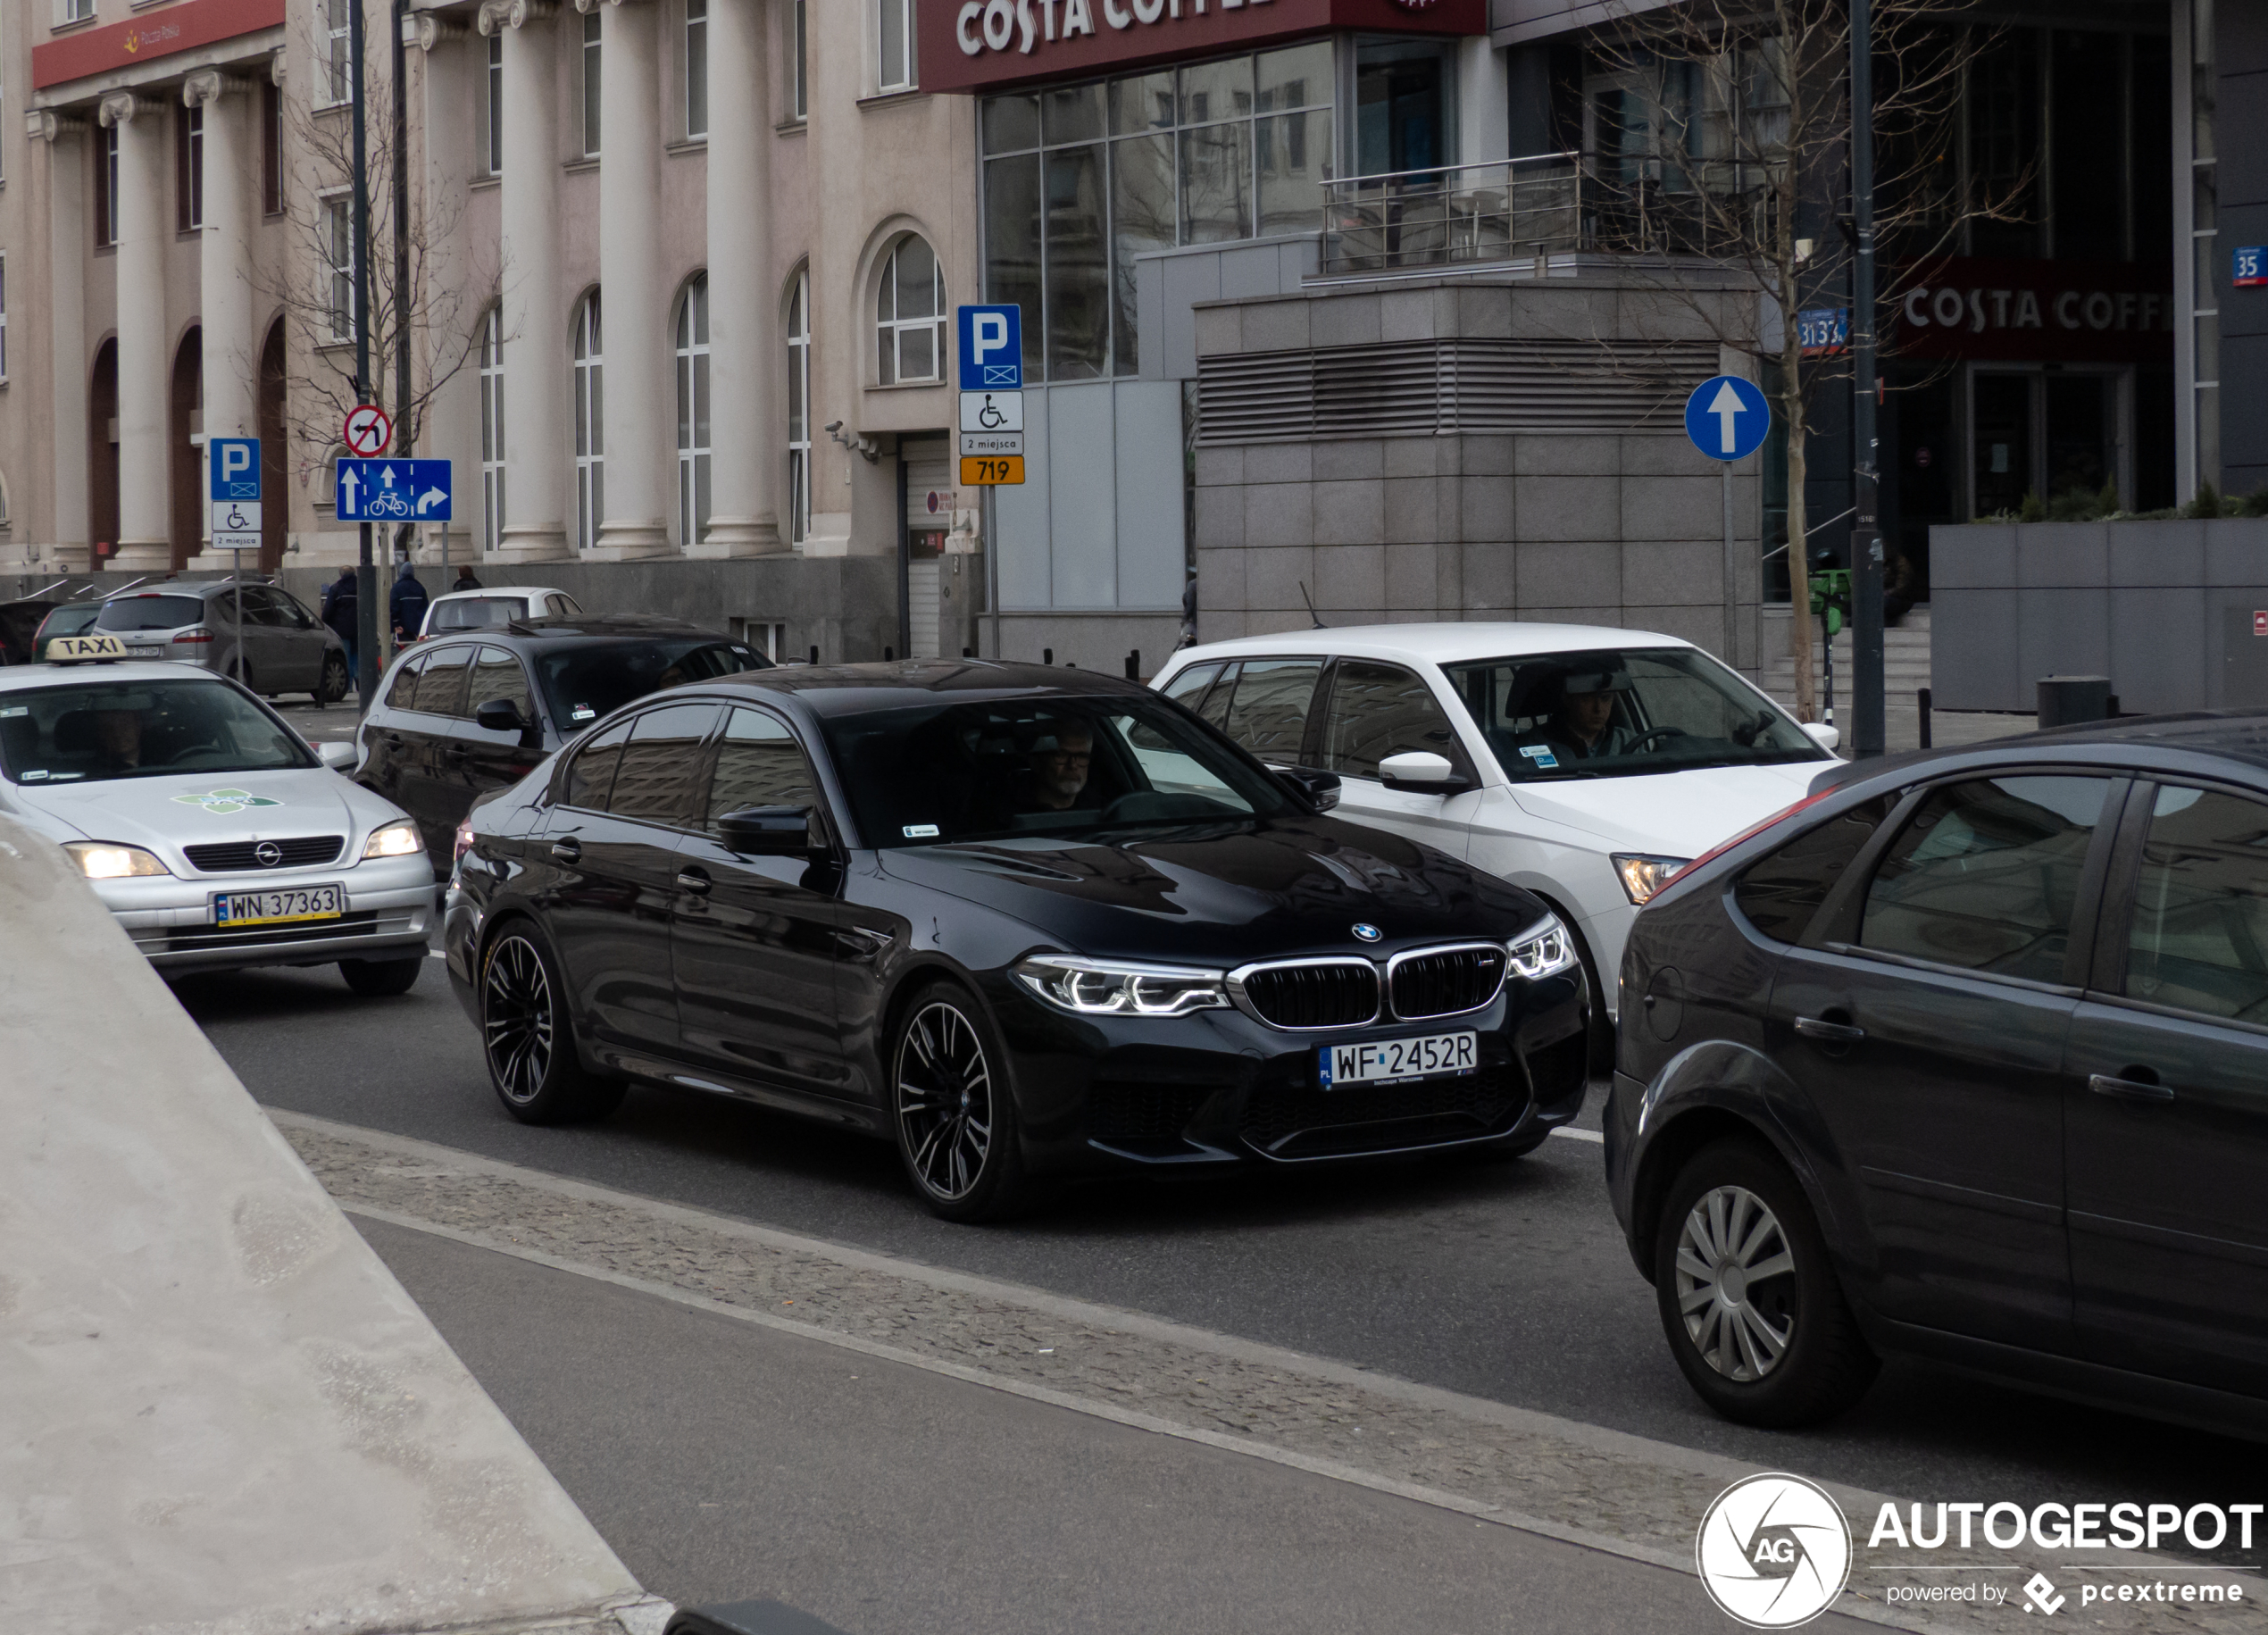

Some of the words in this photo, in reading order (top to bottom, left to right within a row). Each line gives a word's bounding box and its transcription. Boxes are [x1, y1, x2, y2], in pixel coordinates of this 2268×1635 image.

[956, 0, 1096, 55] COSTA
[2238, 255, 2258, 277] 35
[1905, 288, 2043, 333] COSTA
[973, 313, 1008, 365] P
[968, 439, 974, 449] 2
[978, 438, 1017, 454] miejsca
[221, 443, 250, 482] P
[977, 461, 1010, 481] 719
[218, 537, 223, 545] 2
[225, 537, 256, 546] miejsca
[59, 638, 119, 655] TAXI
[231, 895, 263, 919] WN
[270, 889, 335, 916] 37363
[1320, 1070, 1331, 1079] PL
[1338, 1045, 1378, 1080] WF
[1388, 1035, 1473, 1074] 2452R
